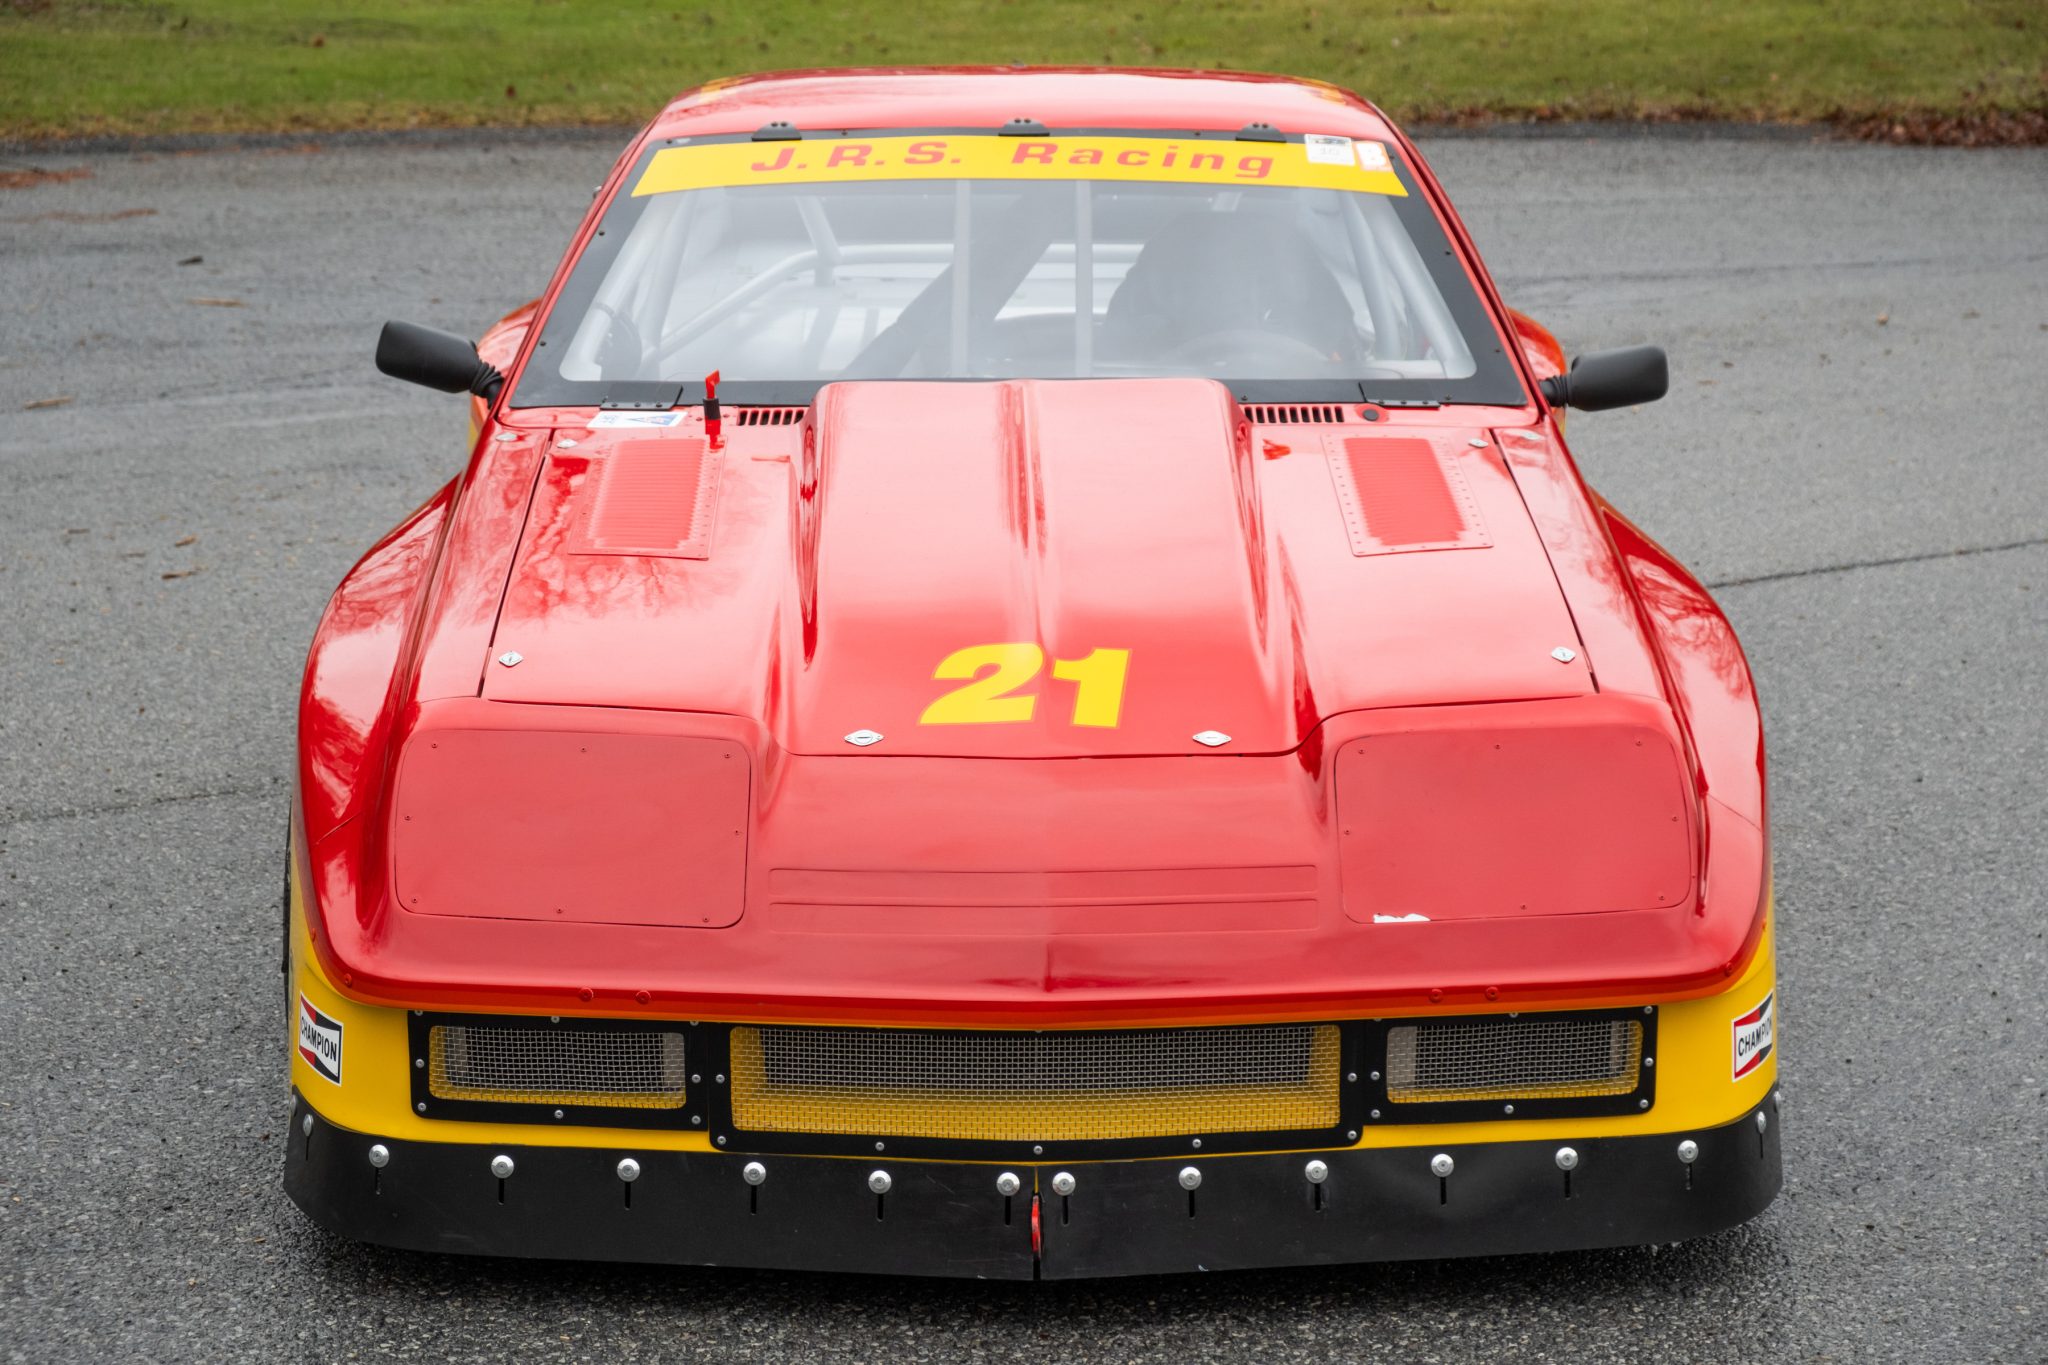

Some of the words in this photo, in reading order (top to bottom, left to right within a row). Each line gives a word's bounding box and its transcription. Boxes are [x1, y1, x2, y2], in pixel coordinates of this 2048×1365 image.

[1012, 141, 1275, 180] Racing
[917, 641, 1132, 729] 21
[301, 1016, 337, 1062] CHAMPION
